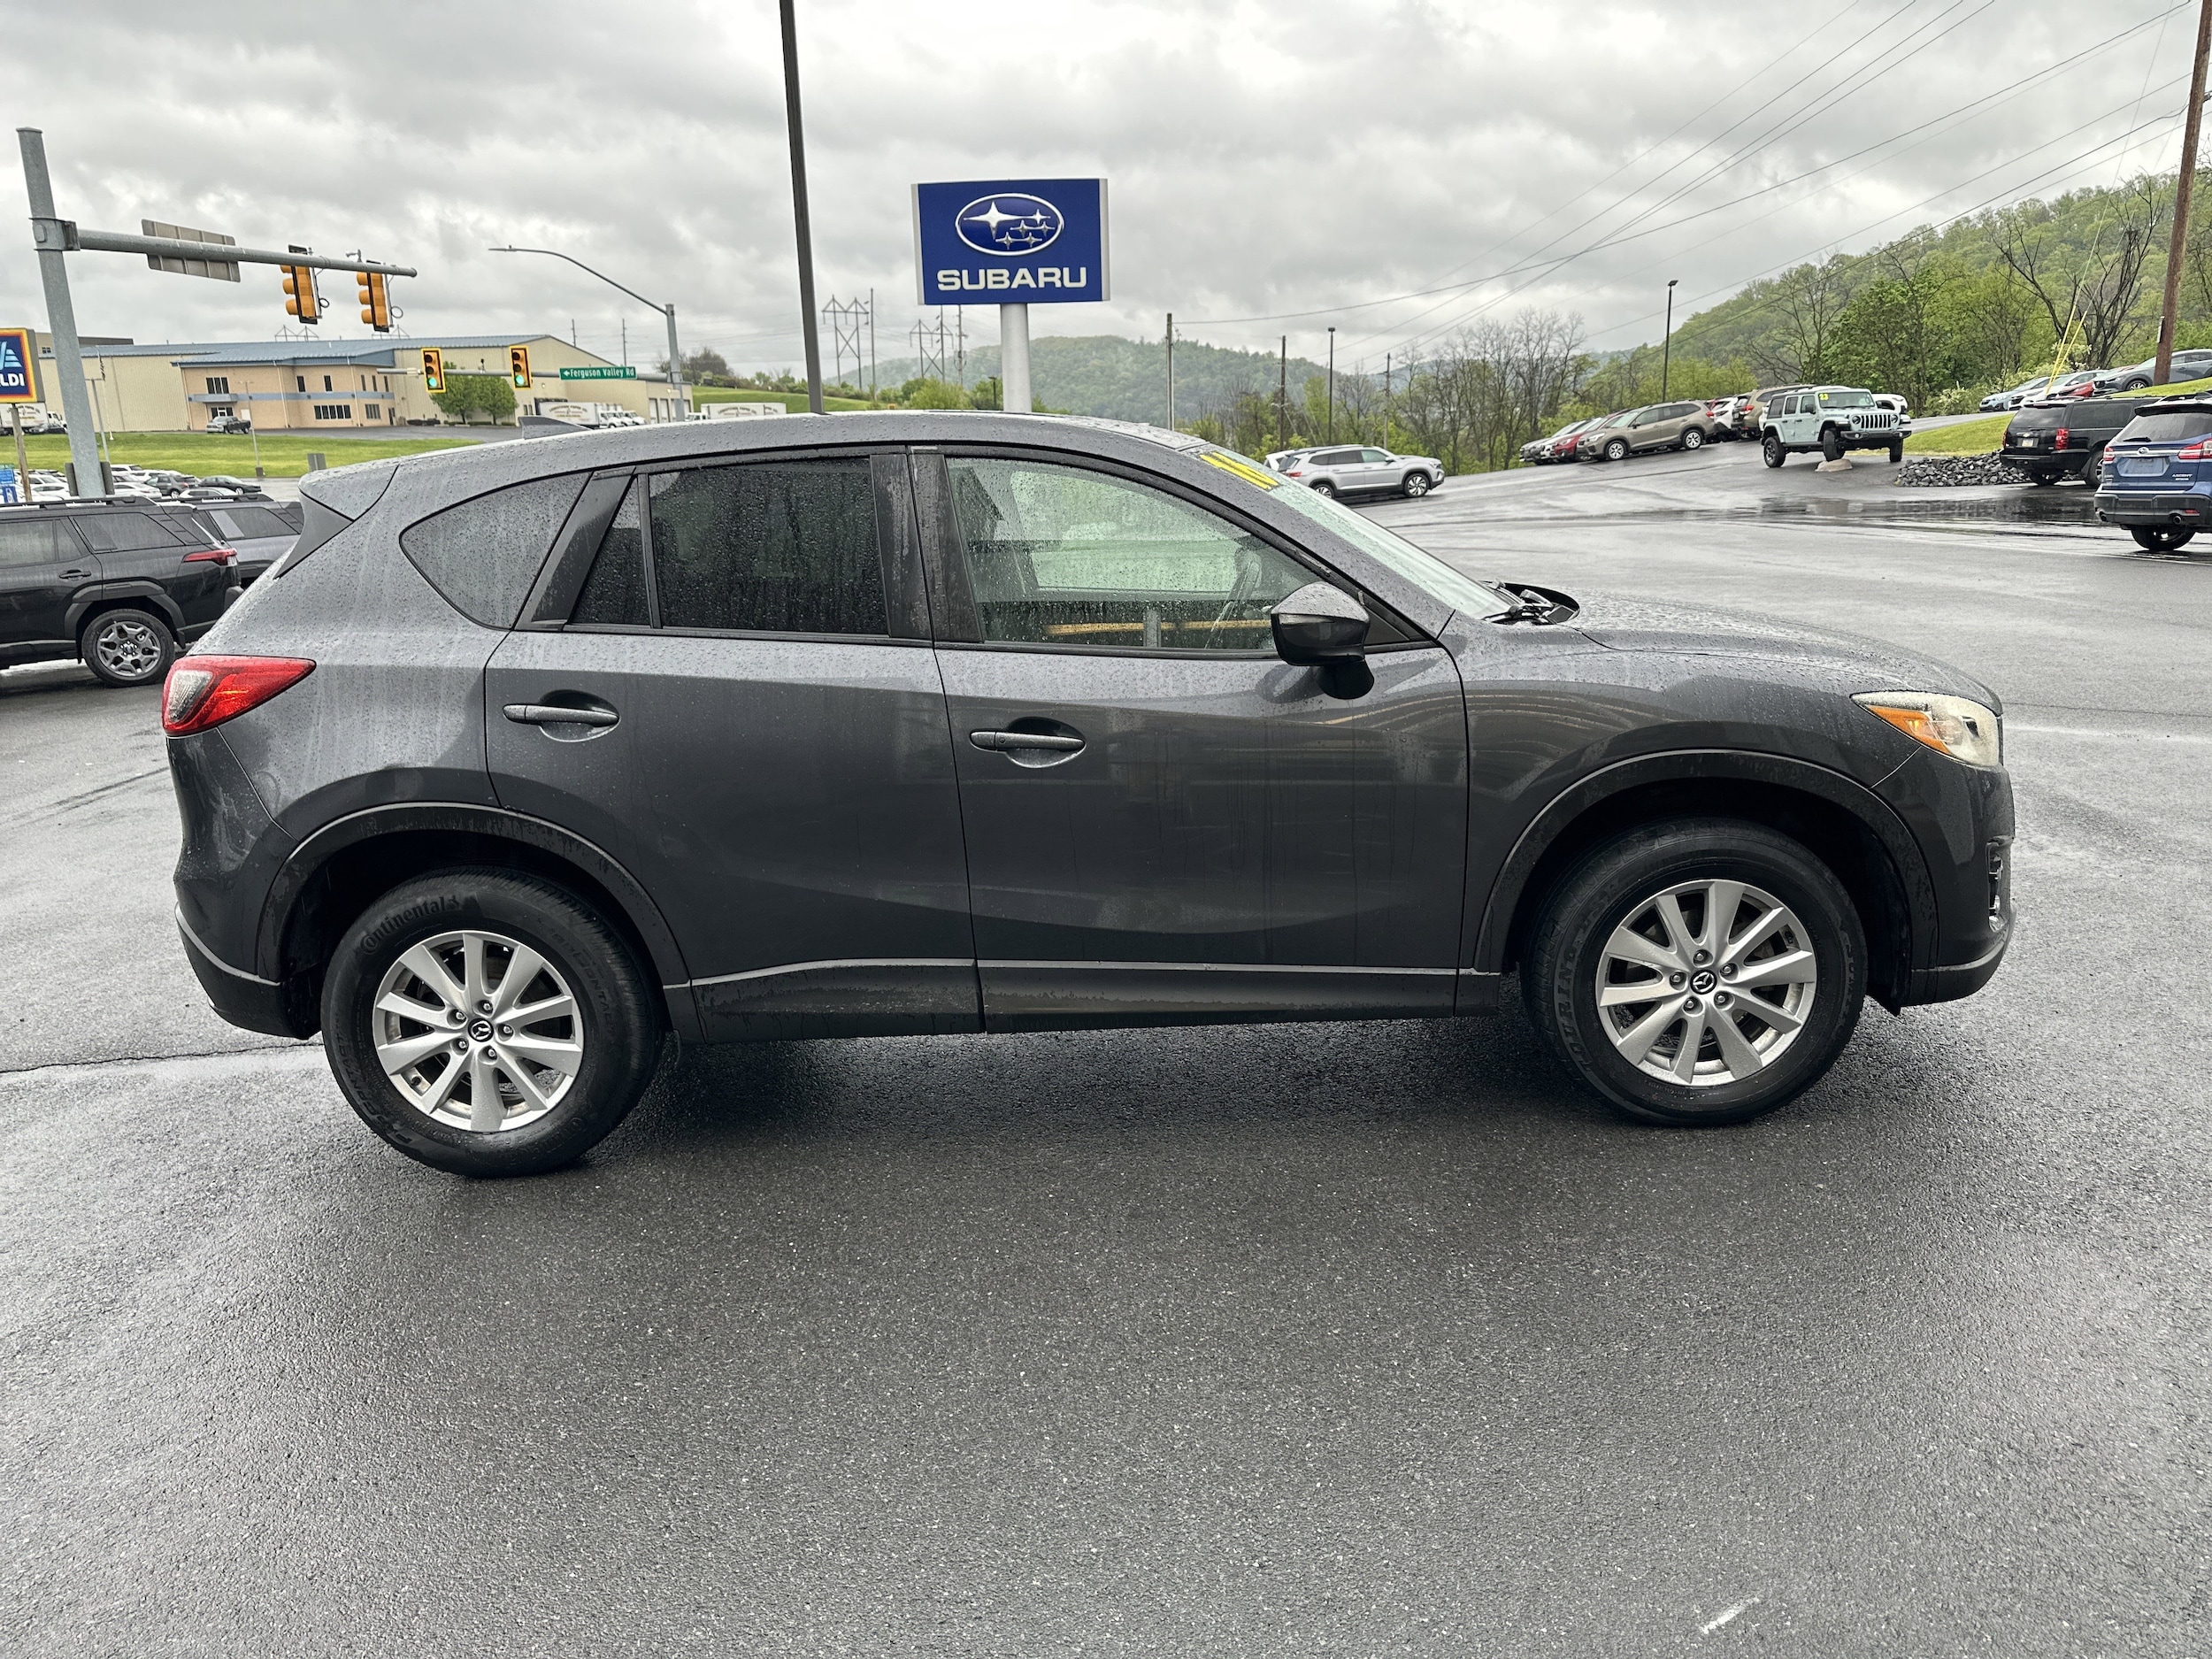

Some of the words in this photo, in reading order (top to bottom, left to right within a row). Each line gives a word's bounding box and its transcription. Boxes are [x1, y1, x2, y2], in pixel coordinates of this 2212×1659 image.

[937, 267, 1087, 291] SUBARU
[0, 373, 25, 387] LDI
[570, 369, 601, 378] Ferguson
[602, 368, 624, 377] Valley
[359, 895, 446, 956] Continental
